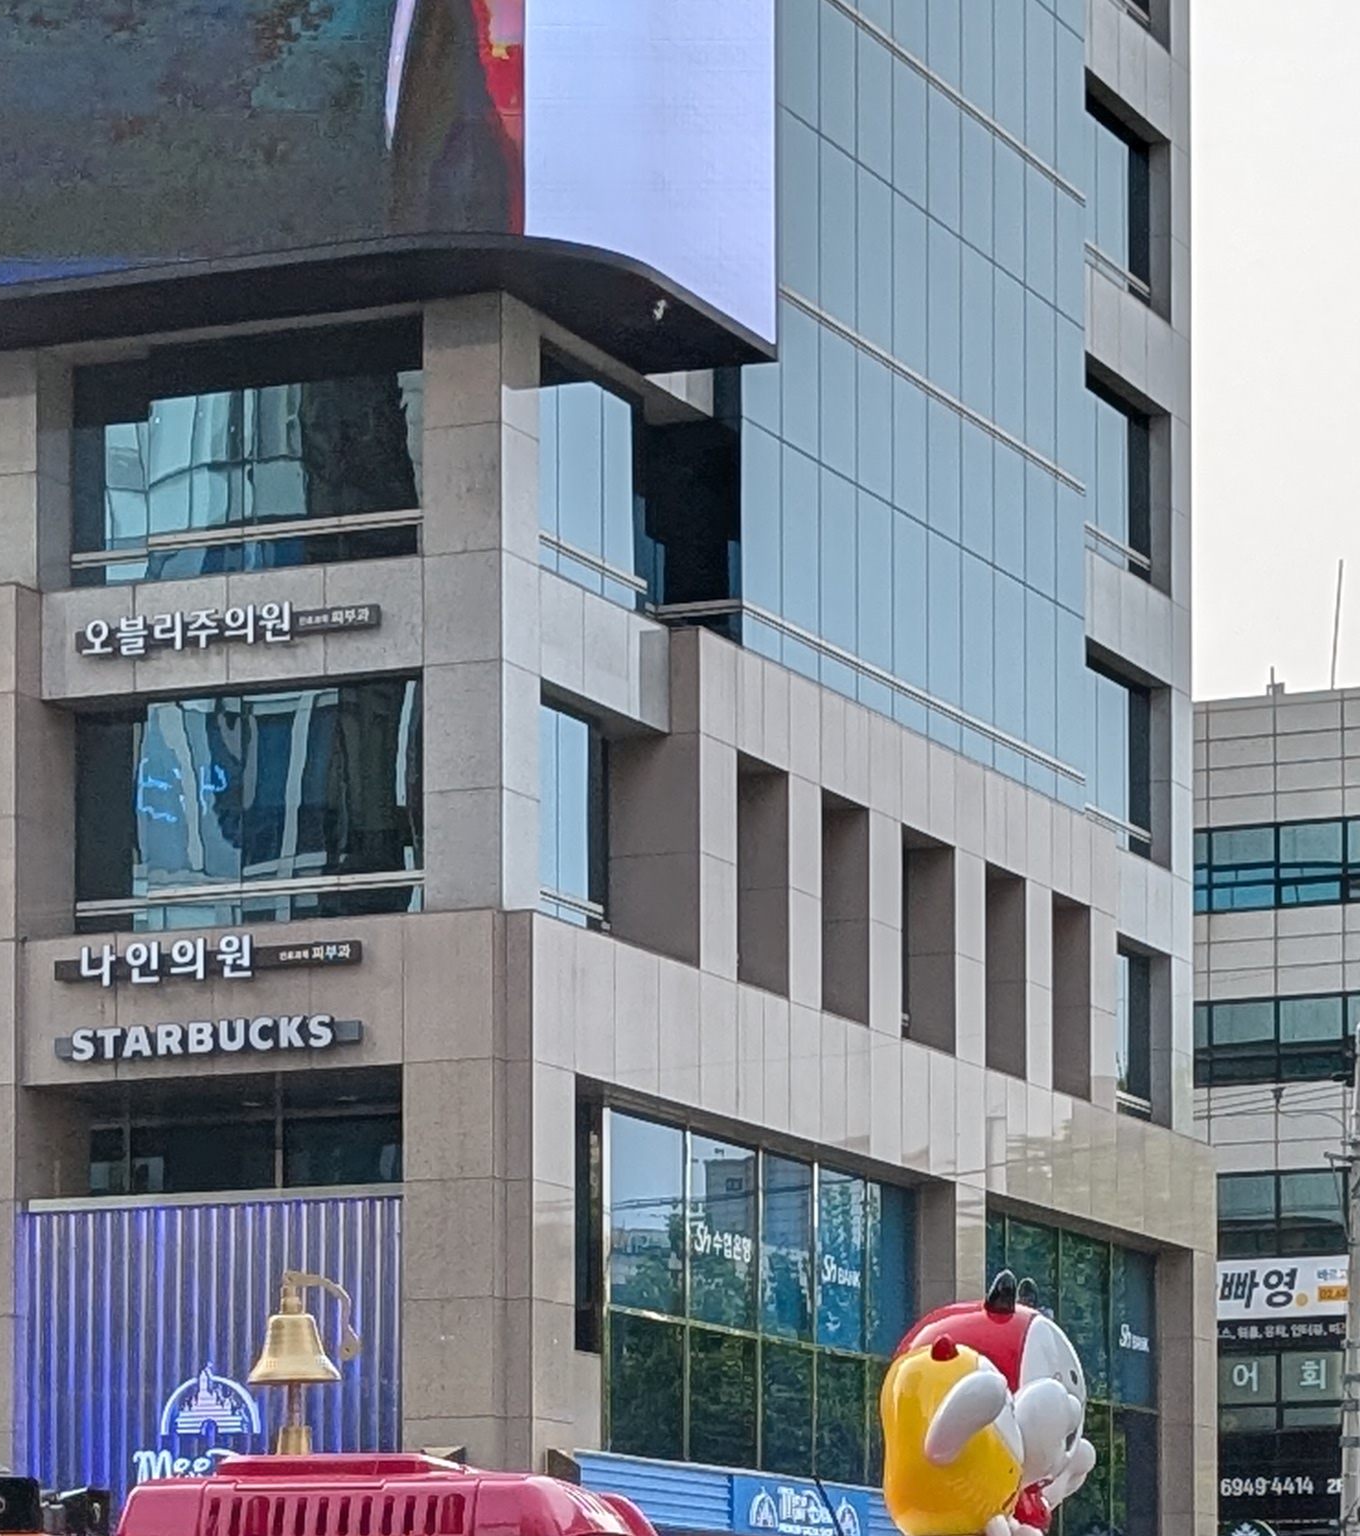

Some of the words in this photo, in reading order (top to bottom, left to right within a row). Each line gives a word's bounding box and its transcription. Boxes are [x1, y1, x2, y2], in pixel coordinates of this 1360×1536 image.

[81, 601, 290, 656] 오블리주의원
[331, 609, 370, 625] 피부과
[80, 933, 253, 987] 나인의원
[312, 943, 352, 962] 피부과
[71, 1014, 334, 1061] STARBUCKS
[1219, 1268, 1299, 1310] 빠영
